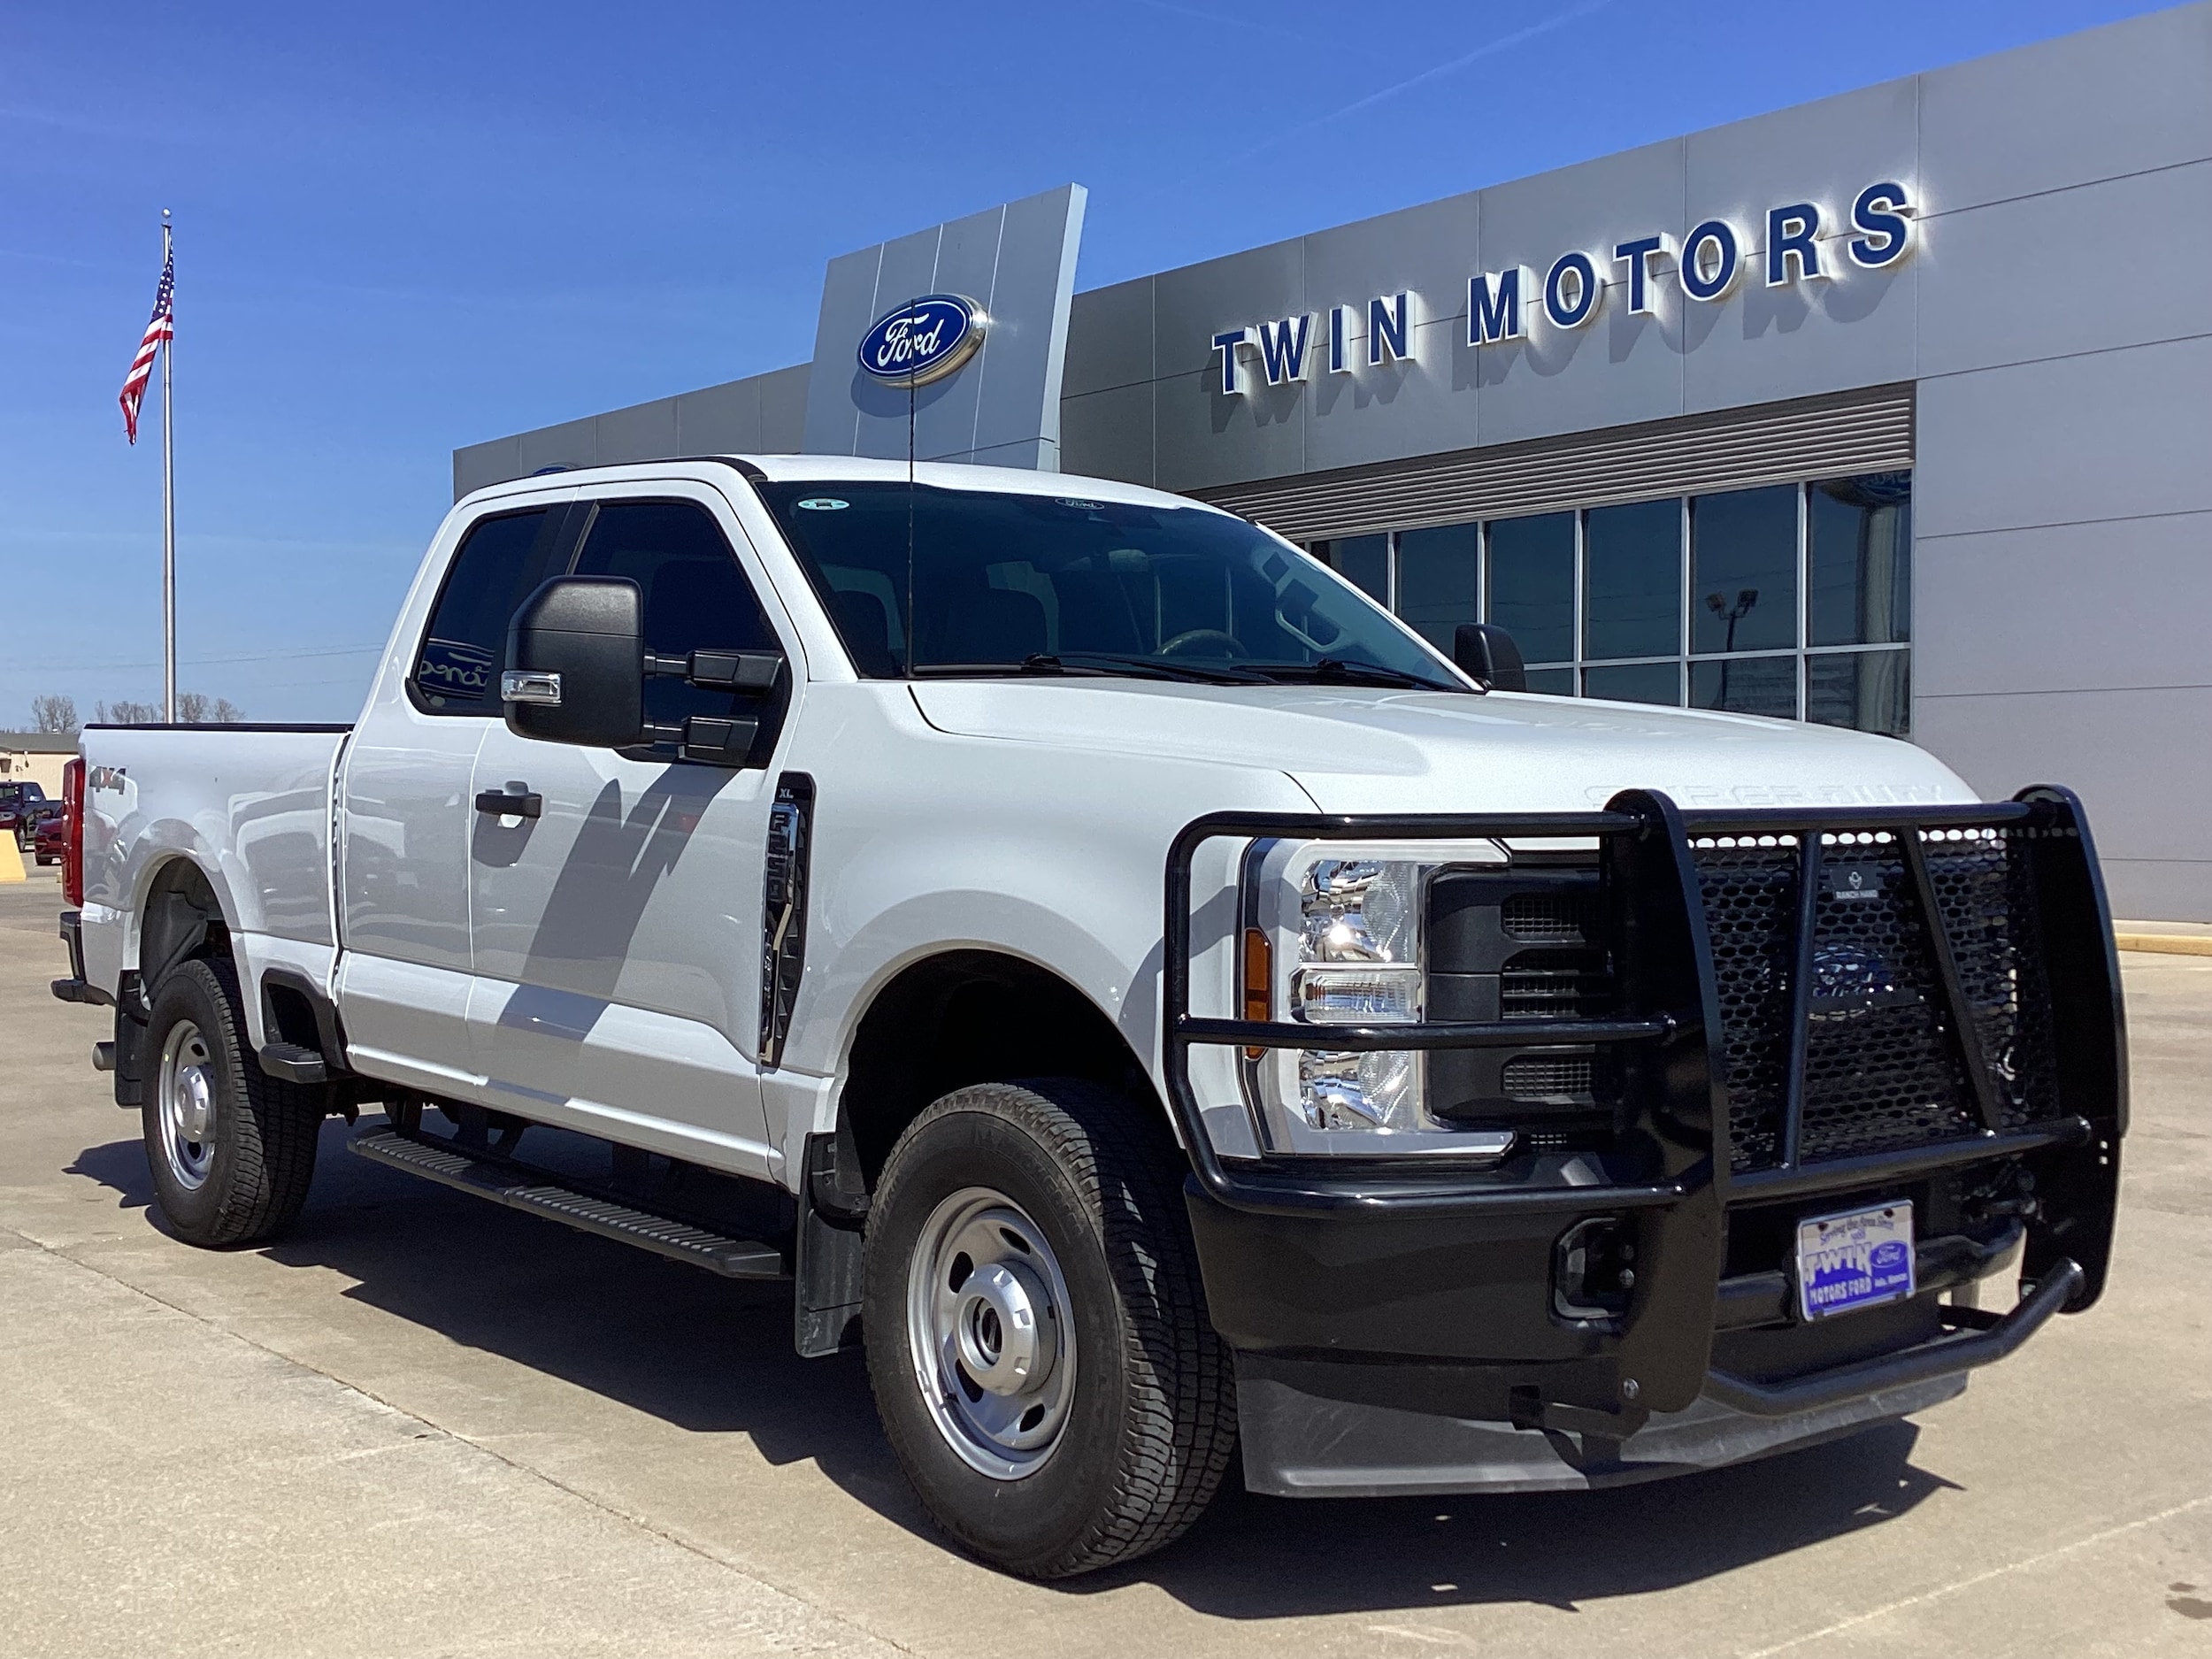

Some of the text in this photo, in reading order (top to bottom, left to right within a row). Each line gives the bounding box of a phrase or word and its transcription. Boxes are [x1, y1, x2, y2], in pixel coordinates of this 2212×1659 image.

[1211, 180, 1918, 396] TWIN MOTORS
[877, 312, 944, 367] Ford
[779, 787, 795, 799] XL
[1805, 1241, 1872, 1286] TWIN
[1876, 1245, 1901, 1264] Ford
[1810, 1281, 1847, 1306] MOTORS
[1848, 1276, 1872, 1297] FORD
